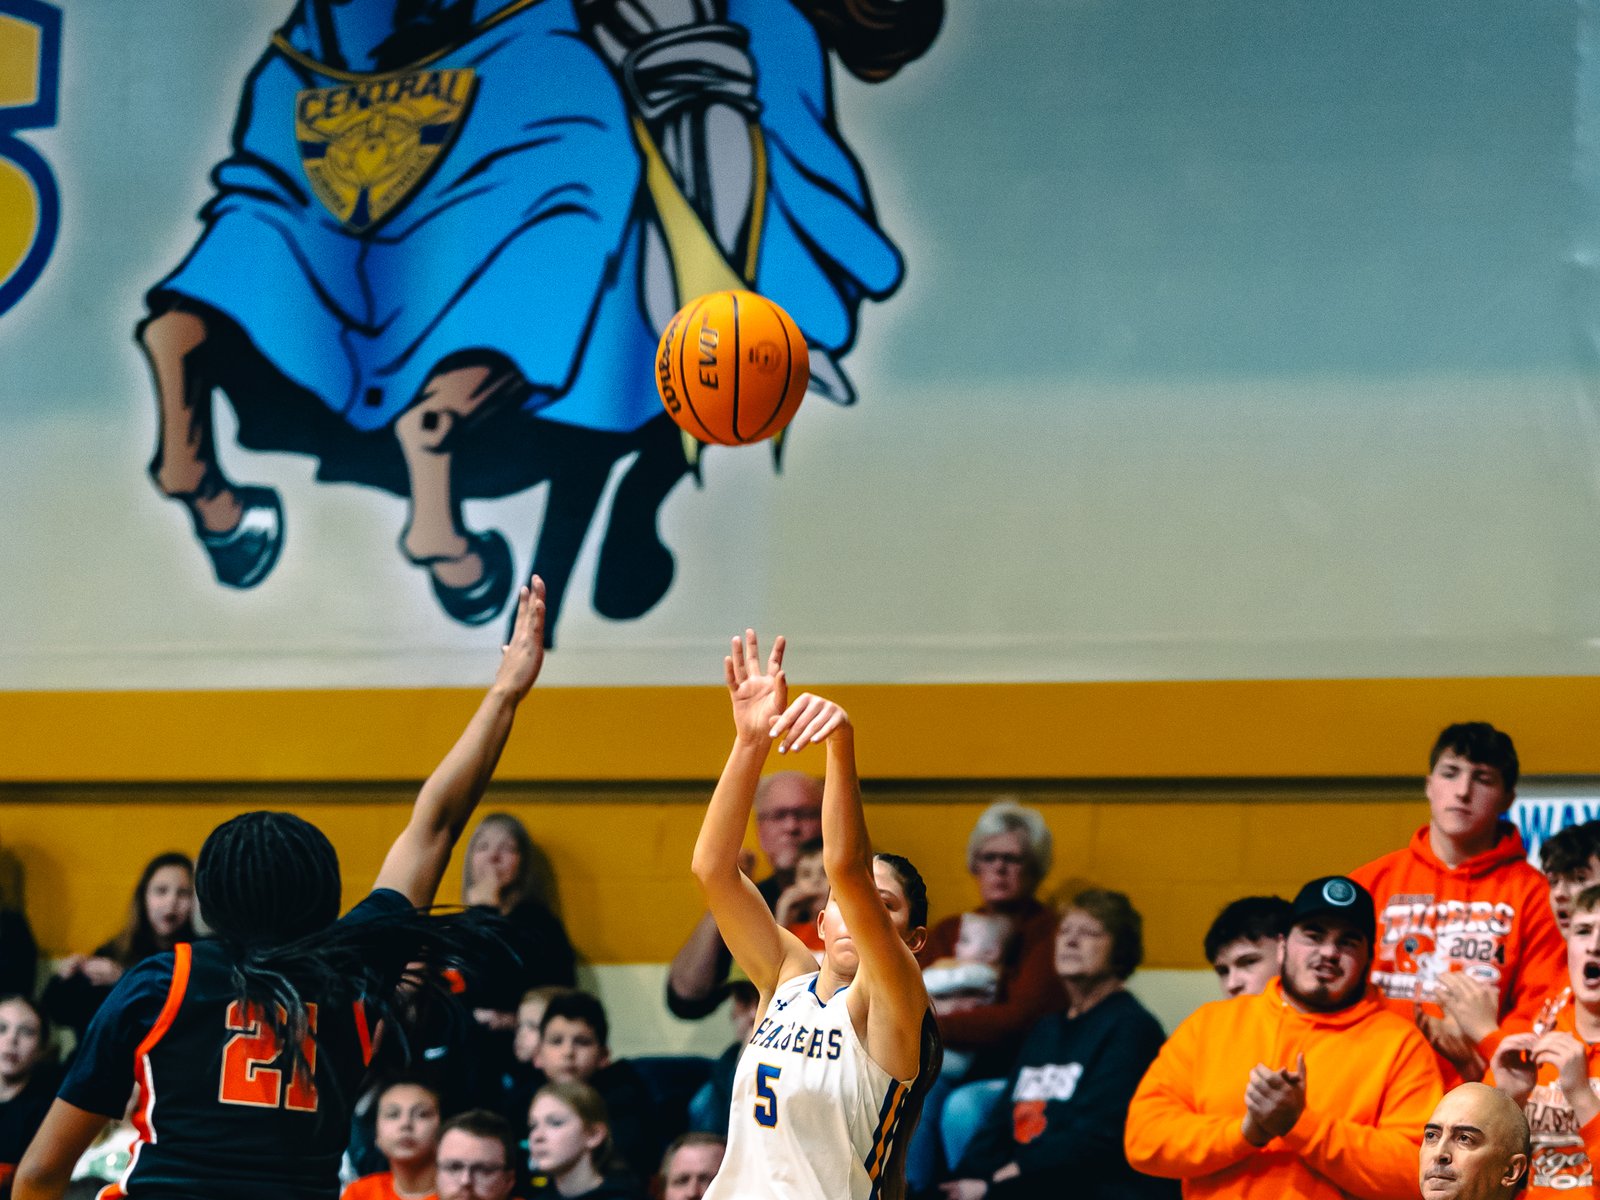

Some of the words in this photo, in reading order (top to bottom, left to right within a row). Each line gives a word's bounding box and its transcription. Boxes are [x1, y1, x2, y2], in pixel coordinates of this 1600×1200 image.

[299, 72, 464, 121] CENTRAL
[1451, 936, 1505, 964] 2024
[219, 999, 318, 1112] 21
[753, 1062, 782, 1129] 5
